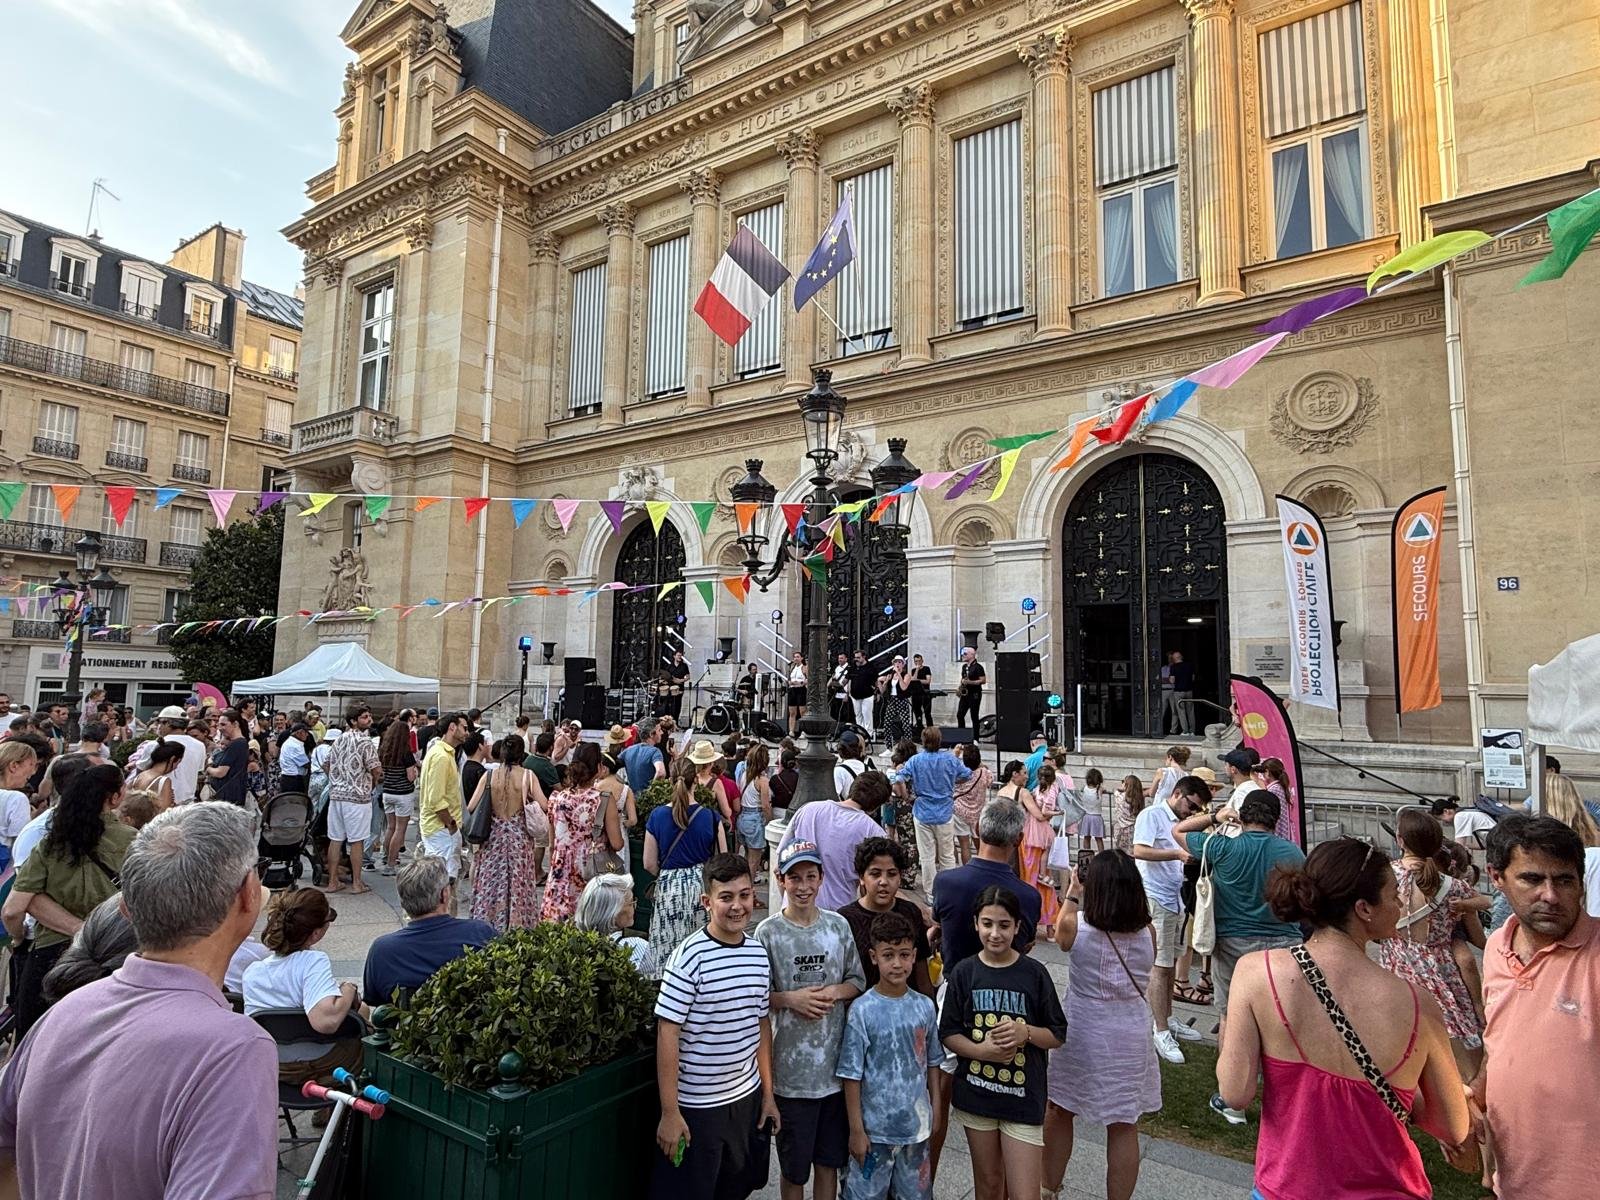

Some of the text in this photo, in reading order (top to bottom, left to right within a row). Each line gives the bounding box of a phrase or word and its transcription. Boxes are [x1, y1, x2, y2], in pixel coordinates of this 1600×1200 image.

[738, 25, 981, 138] HOTEL DE VILLE
[1412, 554, 1428, 622] SECOURS
[1499, 578, 1518, 590] 96
[793, 954, 826, 966] SKATE
[971, 988, 1028, 1017] NIRVANA
